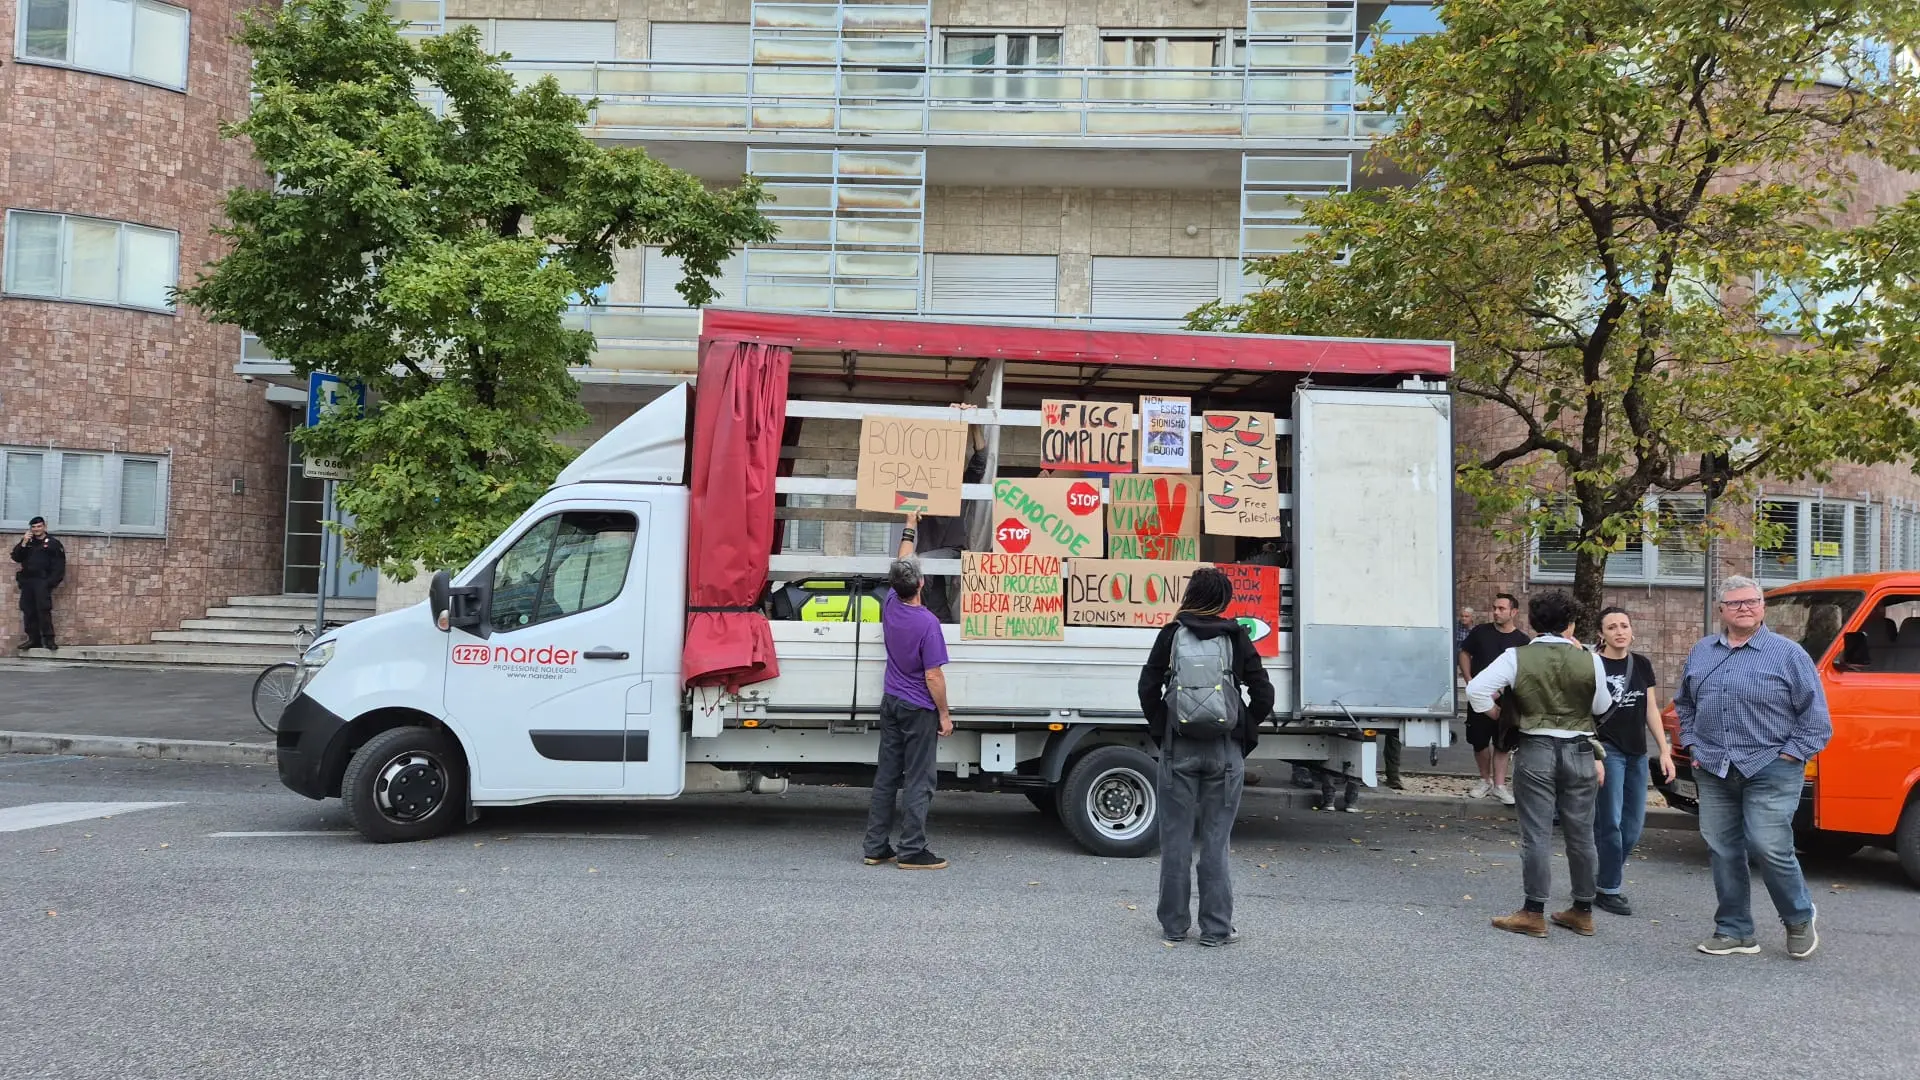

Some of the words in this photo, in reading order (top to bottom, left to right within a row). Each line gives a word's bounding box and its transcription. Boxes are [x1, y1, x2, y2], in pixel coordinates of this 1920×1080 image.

[1060, 404, 1118, 428] FIGC
[1160, 405, 1186, 415] ESISTE
[1151, 419, 1186, 429] SIONISMO
[868, 420, 968, 462] BOYCOTT
[1042, 429, 1129, 465] COMPLICE
[1153, 446, 1184, 457] BUONO
[872, 462, 957, 490] ISRAEL
[1069, 493, 1099, 506] STOP
[1113, 478, 1155, 503] VIVA
[1244, 498, 1267, 509] Free
[994, 479, 1090, 556] GENOCIDE
[1112, 505, 1161, 531] VIVA
[1238, 511, 1280, 524] Palestine
[998, 527, 1031, 541] STOP
[1111, 535, 1196, 560] PALESTINA
[961, 554, 976, 574] LA
[980, 554, 1059, 576] RESISTENZA
[962, 575, 987, 592] NON
[988, 576, 1000, 593] SI
[1003, 576, 1058, 594] PROCESSA
[1071, 572, 1192, 606] DECOLONI
[1233, 579, 1260, 591] OOK
[1013, 596, 1032, 612] PER
[1033, 595, 1063, 613] ANAN
[965, 615, 988, 636] ALI
[995, 615, 1003, 637] E
[1005, 616, 1060, 637] MANSOUR
[1073, 610, 1126, 622] ZIONISM
[1133, 612, 1171, 625] MUST
[455, 648, 488, 661] 1278
[494, 645, 579, 665] narder
[493, 664, 539, 672] PROFESSIONE
[540, 666, 577, 674] NOLEGGIO
[506, 672, 563, 680] www.narder.it
